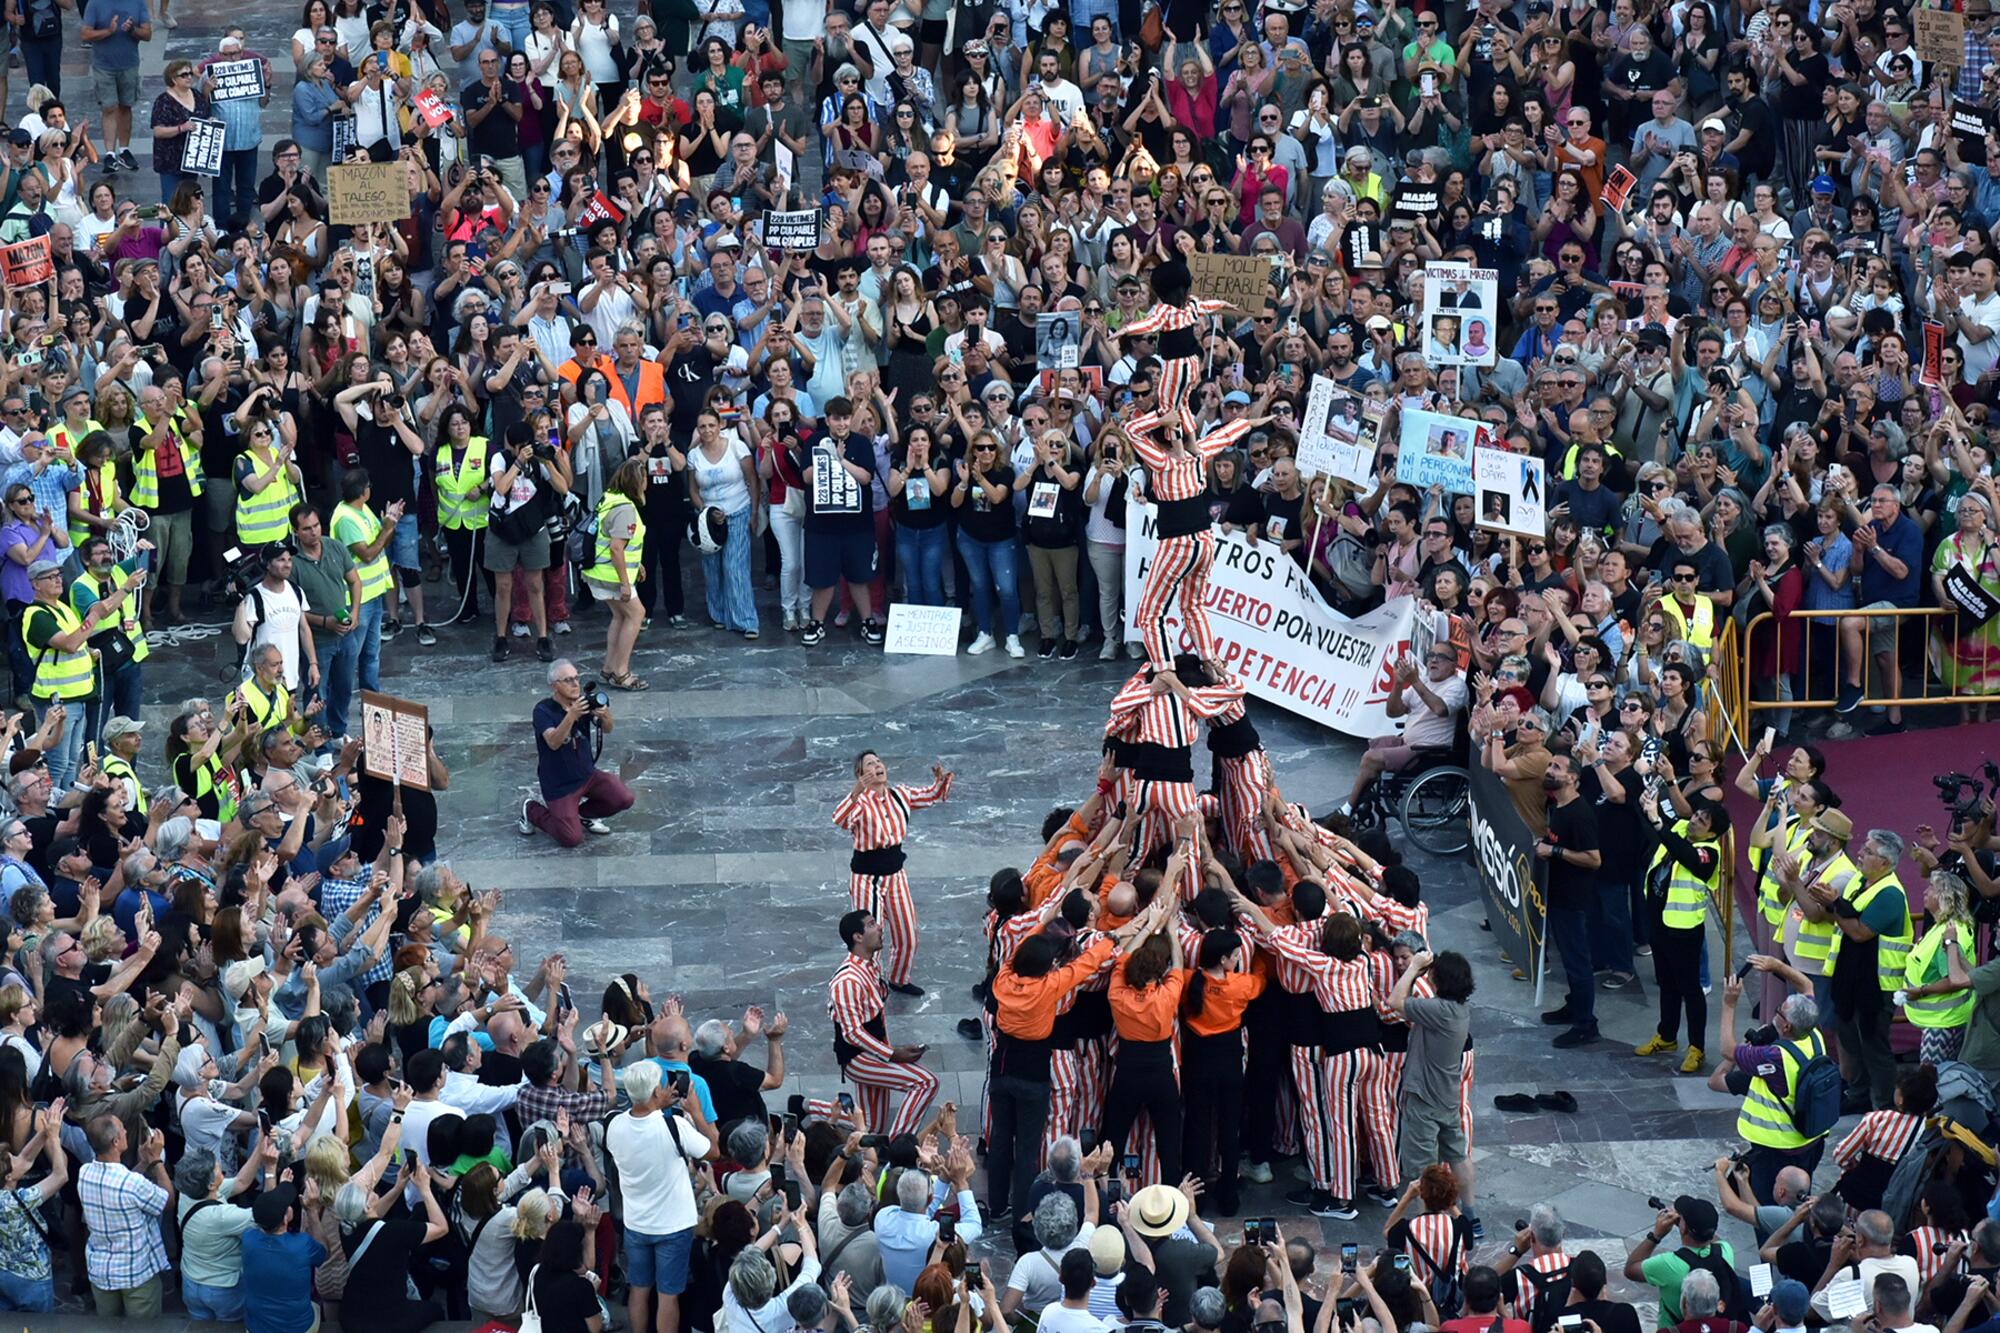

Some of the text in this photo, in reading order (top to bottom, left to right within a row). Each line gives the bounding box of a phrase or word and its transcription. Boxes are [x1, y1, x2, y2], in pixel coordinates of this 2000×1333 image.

[768, 225, 816, 235] PP CULPABLE
[1222, 257, 1261, 274] MOLT
[652, 475, 669, 484] EVA
[894, 635, 955, 650] ASESINOS
[1273, 609, 1313, 645] POR
[1317, 626, 1377, 669] VUESTRA
